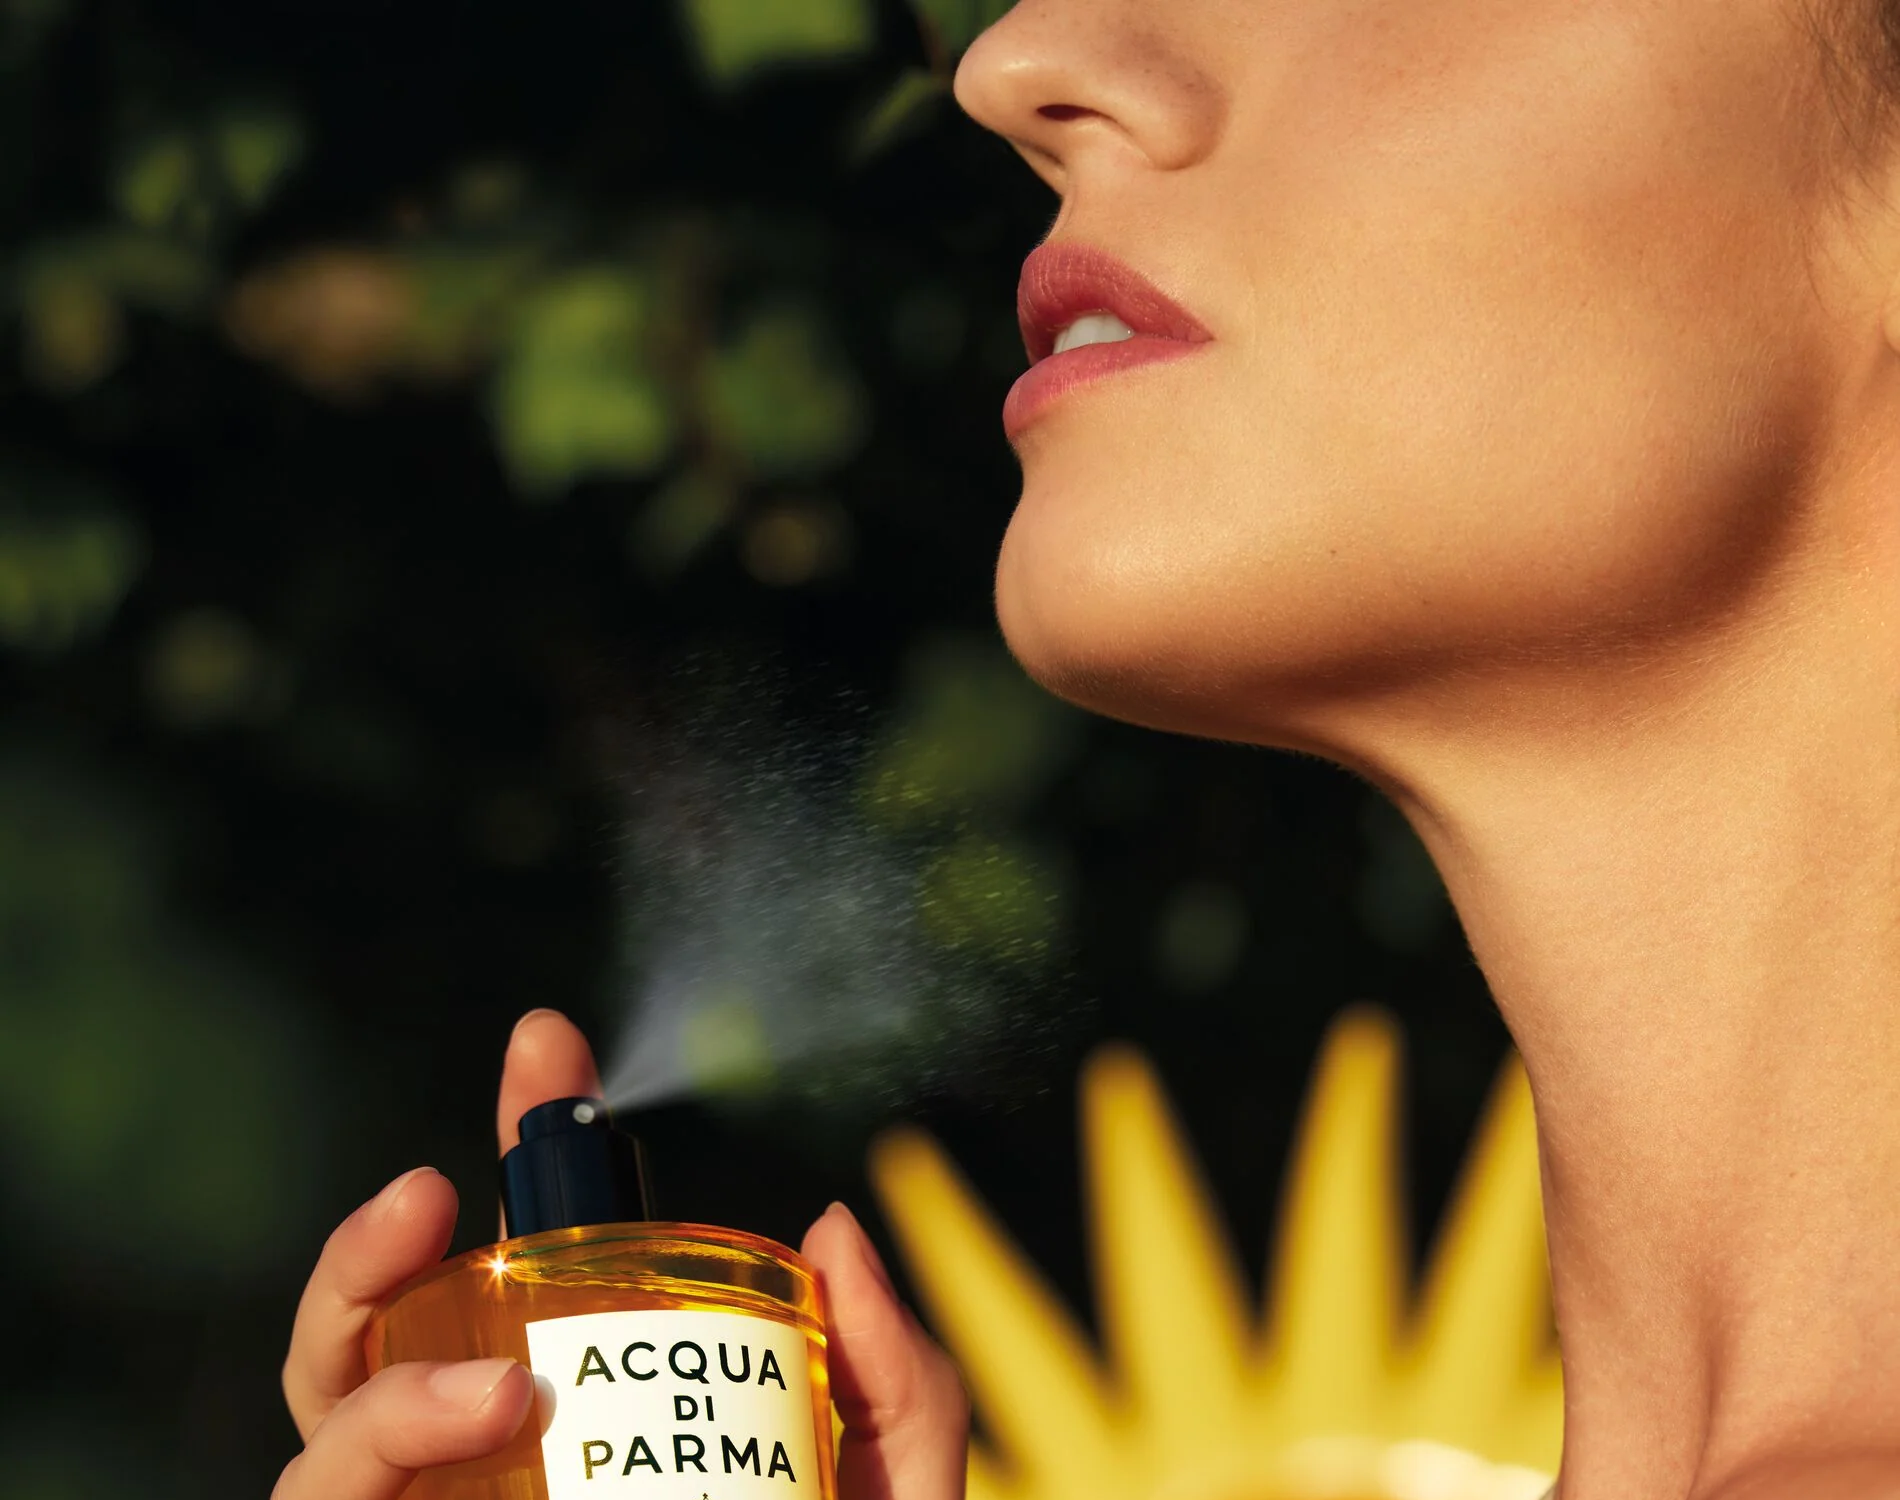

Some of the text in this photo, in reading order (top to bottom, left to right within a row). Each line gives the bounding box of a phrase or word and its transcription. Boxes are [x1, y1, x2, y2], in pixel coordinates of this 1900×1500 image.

[575, 1340, 788, 1391] ACQUA
[673, 1394, 716, 1422] DI
[582, 1433, 798, 1484] PARMA
